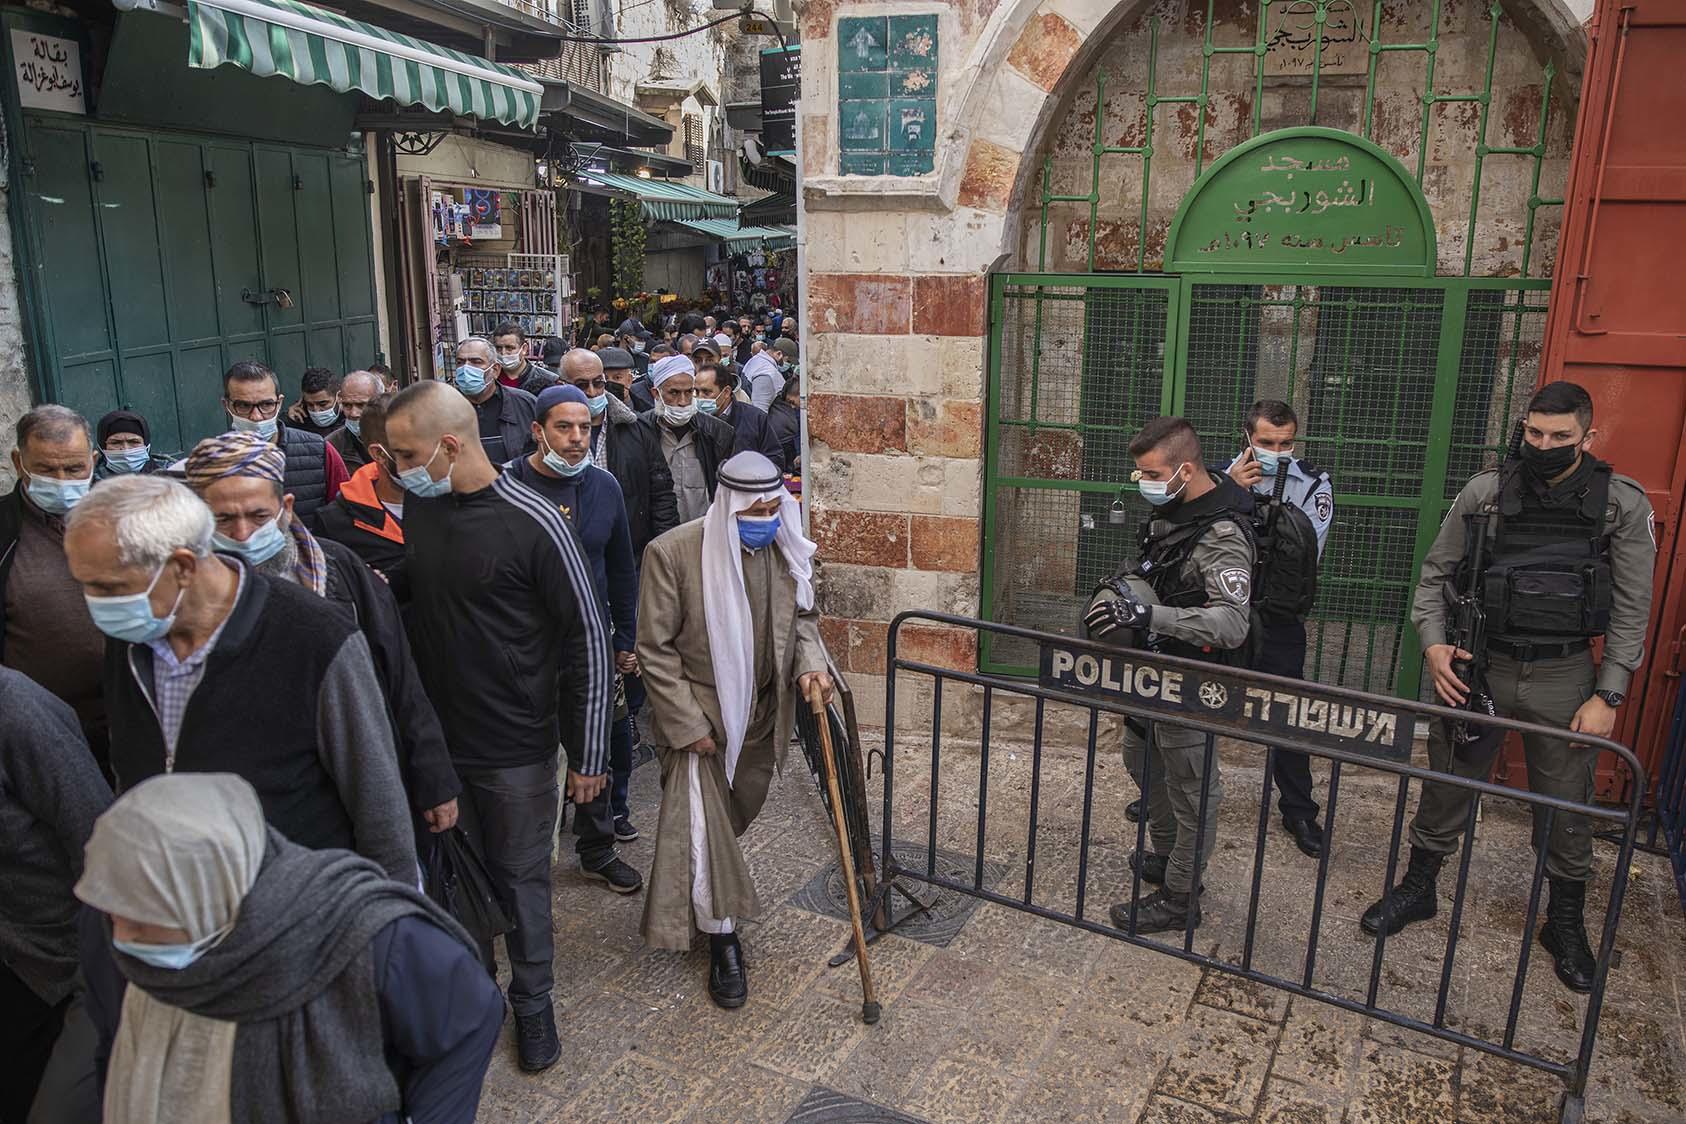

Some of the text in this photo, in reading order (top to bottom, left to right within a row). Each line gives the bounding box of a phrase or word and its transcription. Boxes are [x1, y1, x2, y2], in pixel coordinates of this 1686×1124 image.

[1280, 4, 1350, 16] مسد
[746, 23, 763, 32] 244
[1266, 18, 1364, 52] الشوربجي
[31, 38, 67, 68] بقالة
[20, 62, 49, 92] غزالة
[55, 75, 83, 97] يوسف
[1261, 155, 1350, 180] مسجد
[1233, 177, 1375, 223] الشوربجي
[1051, 648, 1184, 704] POLICE
[1243, 687, 1397, 746] משטרה
